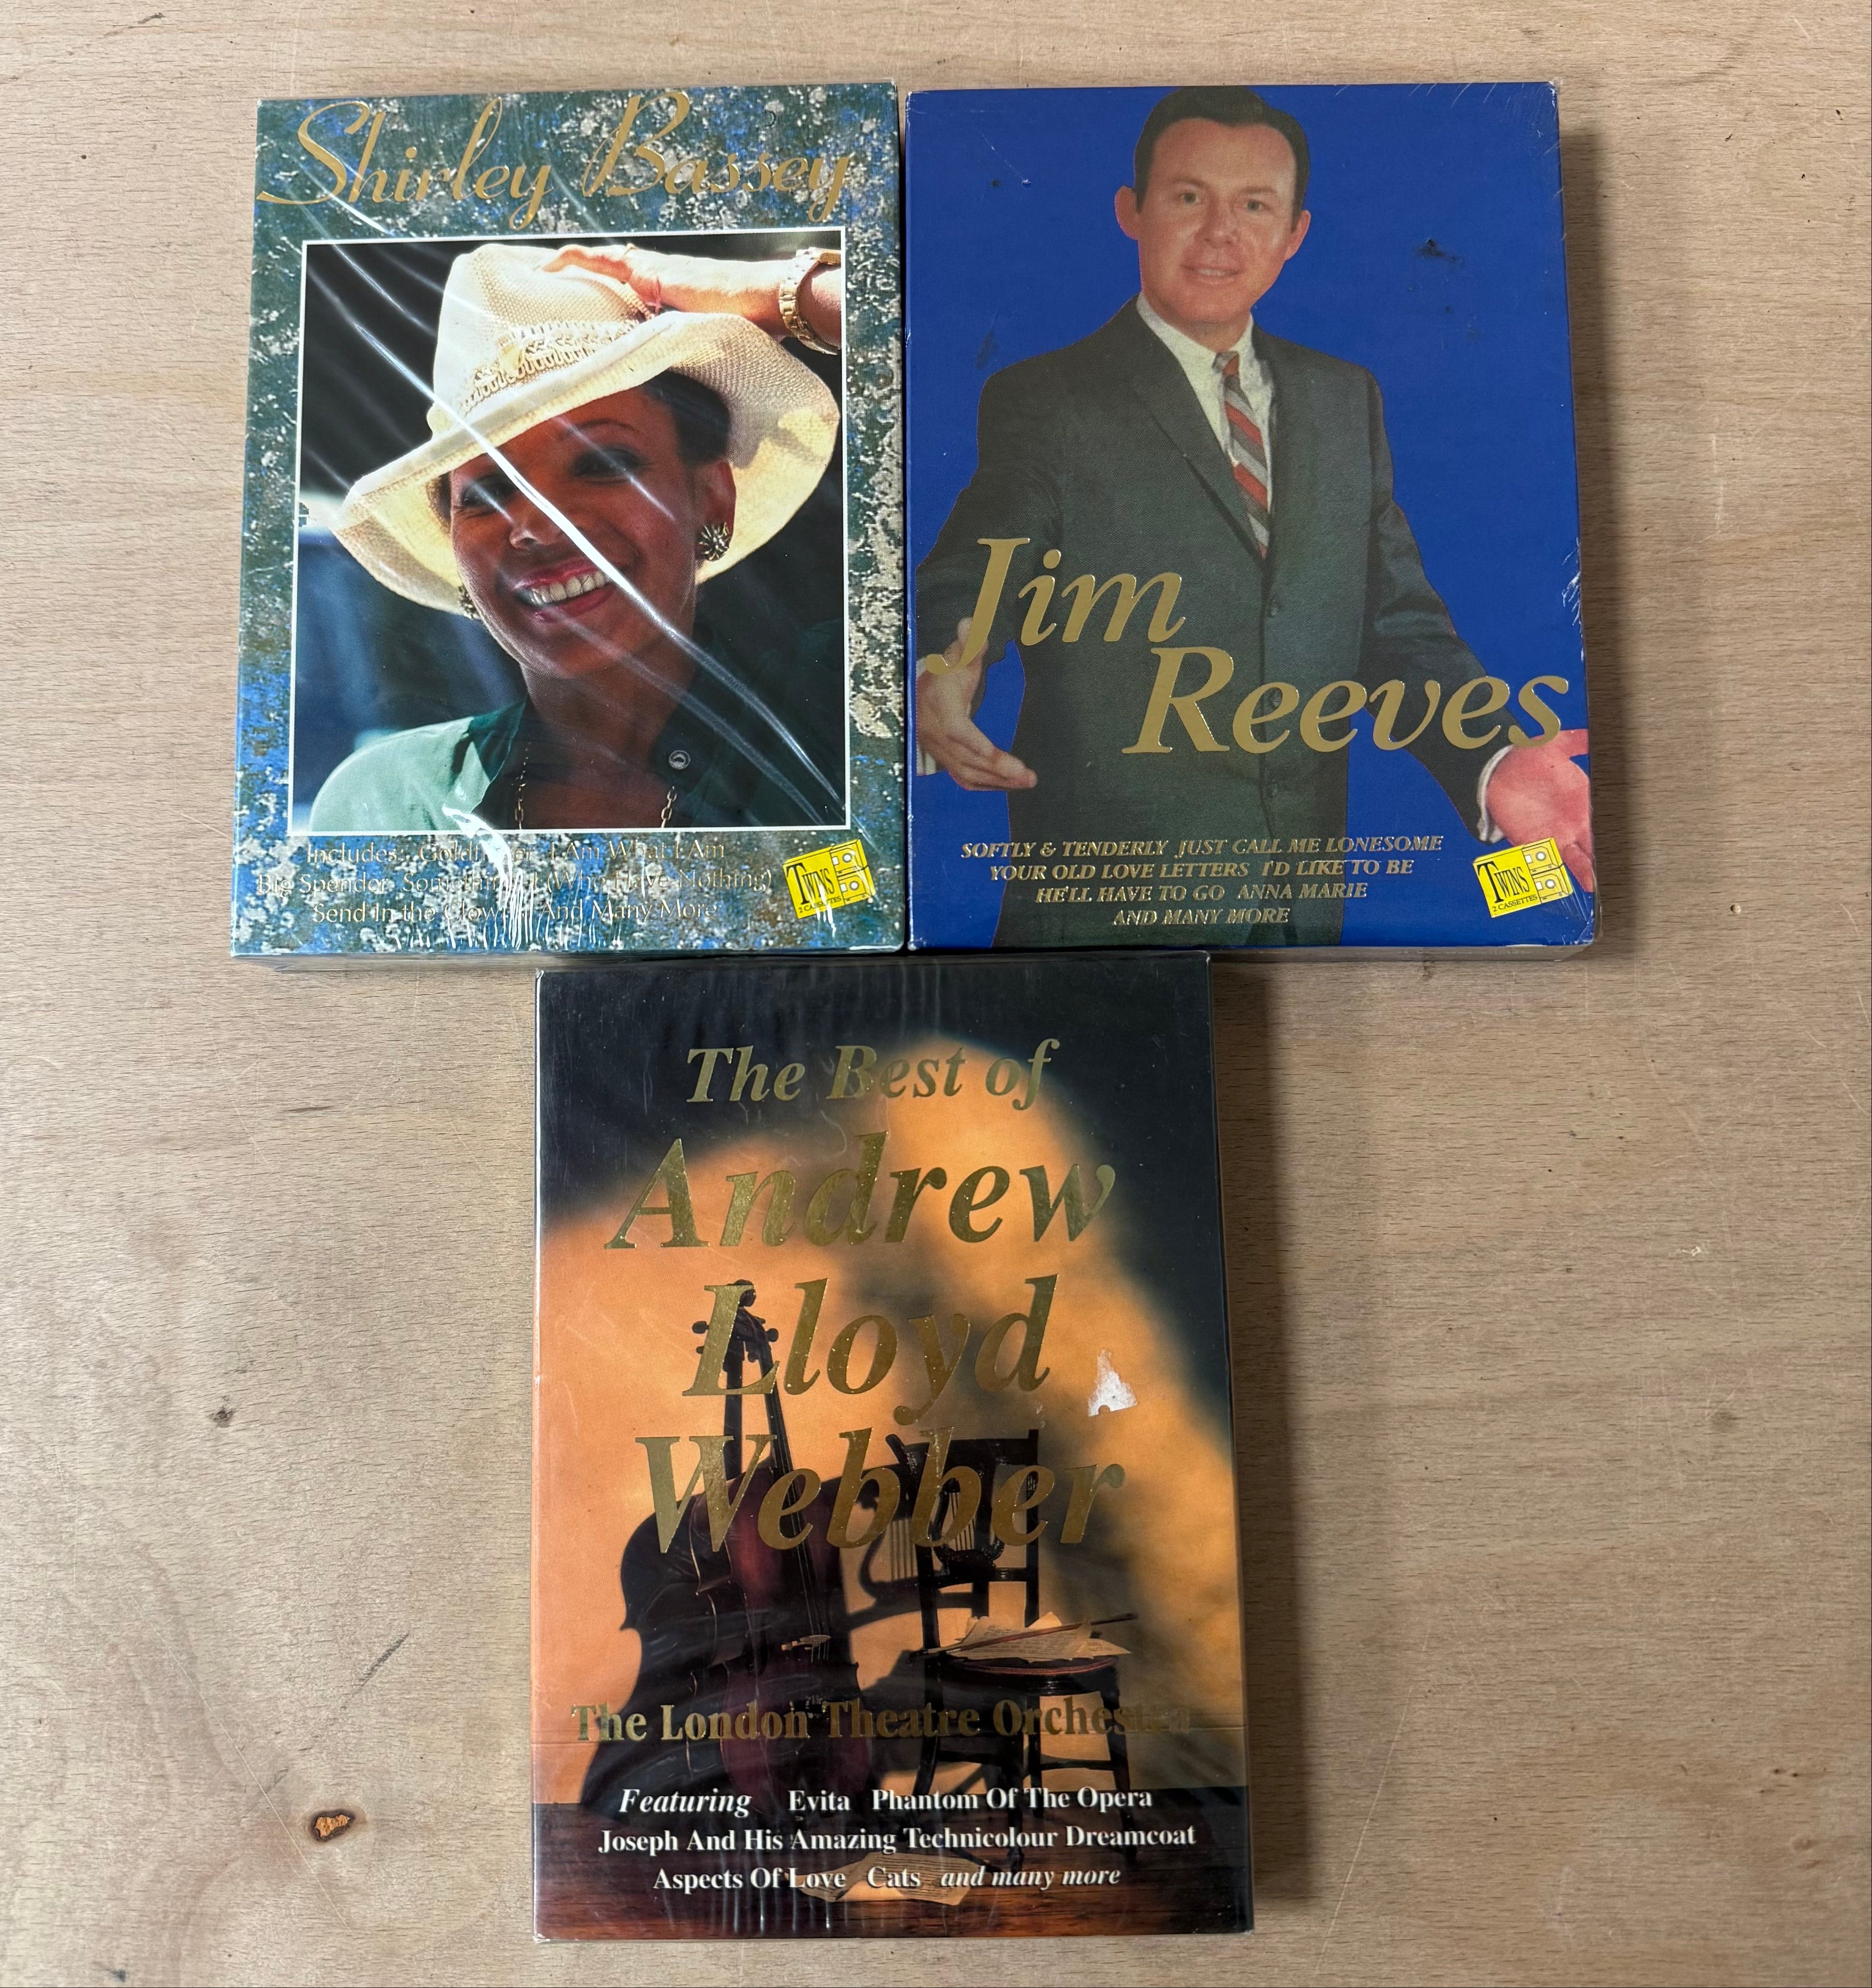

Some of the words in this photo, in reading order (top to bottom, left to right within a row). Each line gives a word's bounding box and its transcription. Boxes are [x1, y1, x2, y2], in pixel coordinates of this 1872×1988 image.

[255, 97, 552, 230] Shirley
[582, 92, 849, 223] Bassey
[925, 537, 1186, 674] Jim
[1122, 647, 1569, 754] Reeves
[306, 841, 404, 864] Includes:
[418, 840, 536, 862] Goldfier
[564, 842, 600, 860] Am
[688, 839, 725, 859] Am
[960, 842, 1037, 859] SOFTLY
[1039, 842, 1057, 858] &
[1062, 840, 1169, 858] TENDERLY
[1173, 839, 1228, 859] JUST
[1232, 838, 1289, 854] CALL
[1290, 837, 1321, 853] ME
[1325, 835, 1444, 852] LONESOME
[257, 874, 293, 898] Big
[299, 872, 389, 898] Spender
[679, 867, 772, 892] Nothing)
[990, 865, 1047, 881] YOUR
[1052, 864, 1096, 880] OLD
[1101, 864, 1154, 879] LOVE
[1159, 862, 1249, 878] LETTERS
[1262, 861, 1292, 877] I'D
[1296, 860, 1344, 876] LIKE
[1351, 860, 1380, 875] TO
[1386, 859, 1414, 874] BE
[1034, 886, 1093, 903] HE'LL
[1096, 886, 1153, 902] HAVE
[1158, 885, 1187, 902] TO
[1192, 885, 1225, 901] GO
[1237, 885, 1293, 900] ANNA
[1298, 883, 1369, 899] MARIE
[1498, 894, 1538, 910] CASSETTES
[312, 901, 366, 923] Send
[374, 902, 394, 923] In
[402, 901, 437, 923] the
[444, 899, 526, 921] Clow
[539, 899, 584, 920] And
[591, 900, 653, 925] Many
[660, 898, 717, 919] More
[1112, 909, 1157, 926] AND
[1161, 908, 1223, 925] MANY
[1226, 907, 1290, 924] MORE
[686, 1045, 806, 1103] The
[826, 1044, 969, 1100] Best
[985, 1038, 1060, 1111] of
[604, 1130, 1115, 1249] Andrew
[682, 1274, 1059, 1425] Lloyd
[635, 1426, 1126, 1554] Webber
[570, 1702, 648, 1742] The
[660, 1699, 811, 1741] London
[821, 1698, 981, 1739] Theatre
[618, 1788, 752, 1818] Featuring
[788, 1789, 851, 1811] Evita
[872, 1788, 979, 1811] Phantom
[986, 1787, 1018, 1809] Of
[1024, 1787, 1070, 1809] The
[1076, 1786, 1153, 1813] Opera
[598, 1829, 679, 1855] Joseph
[686, 1829, 736, 1851] And
[744, 1829, 783, 1850] His
[790, 1827, 897, 1854] Amazing
[902, 1826, 1058, 1850] Technicolour
[1065, 1825, 1196, 1848] Dreamcoat
[652, 1867, 743, 1894] Aspects
[749, 1867, 783, 1890] Of
[789, 1867, 846, 1889] Love
[867, 1866, 921, 1889] Cats
[940, 1865, 986, 1887] and
[991, 1868, 1055, 1891] many
[1061, 1868, 1121, 1887] more
